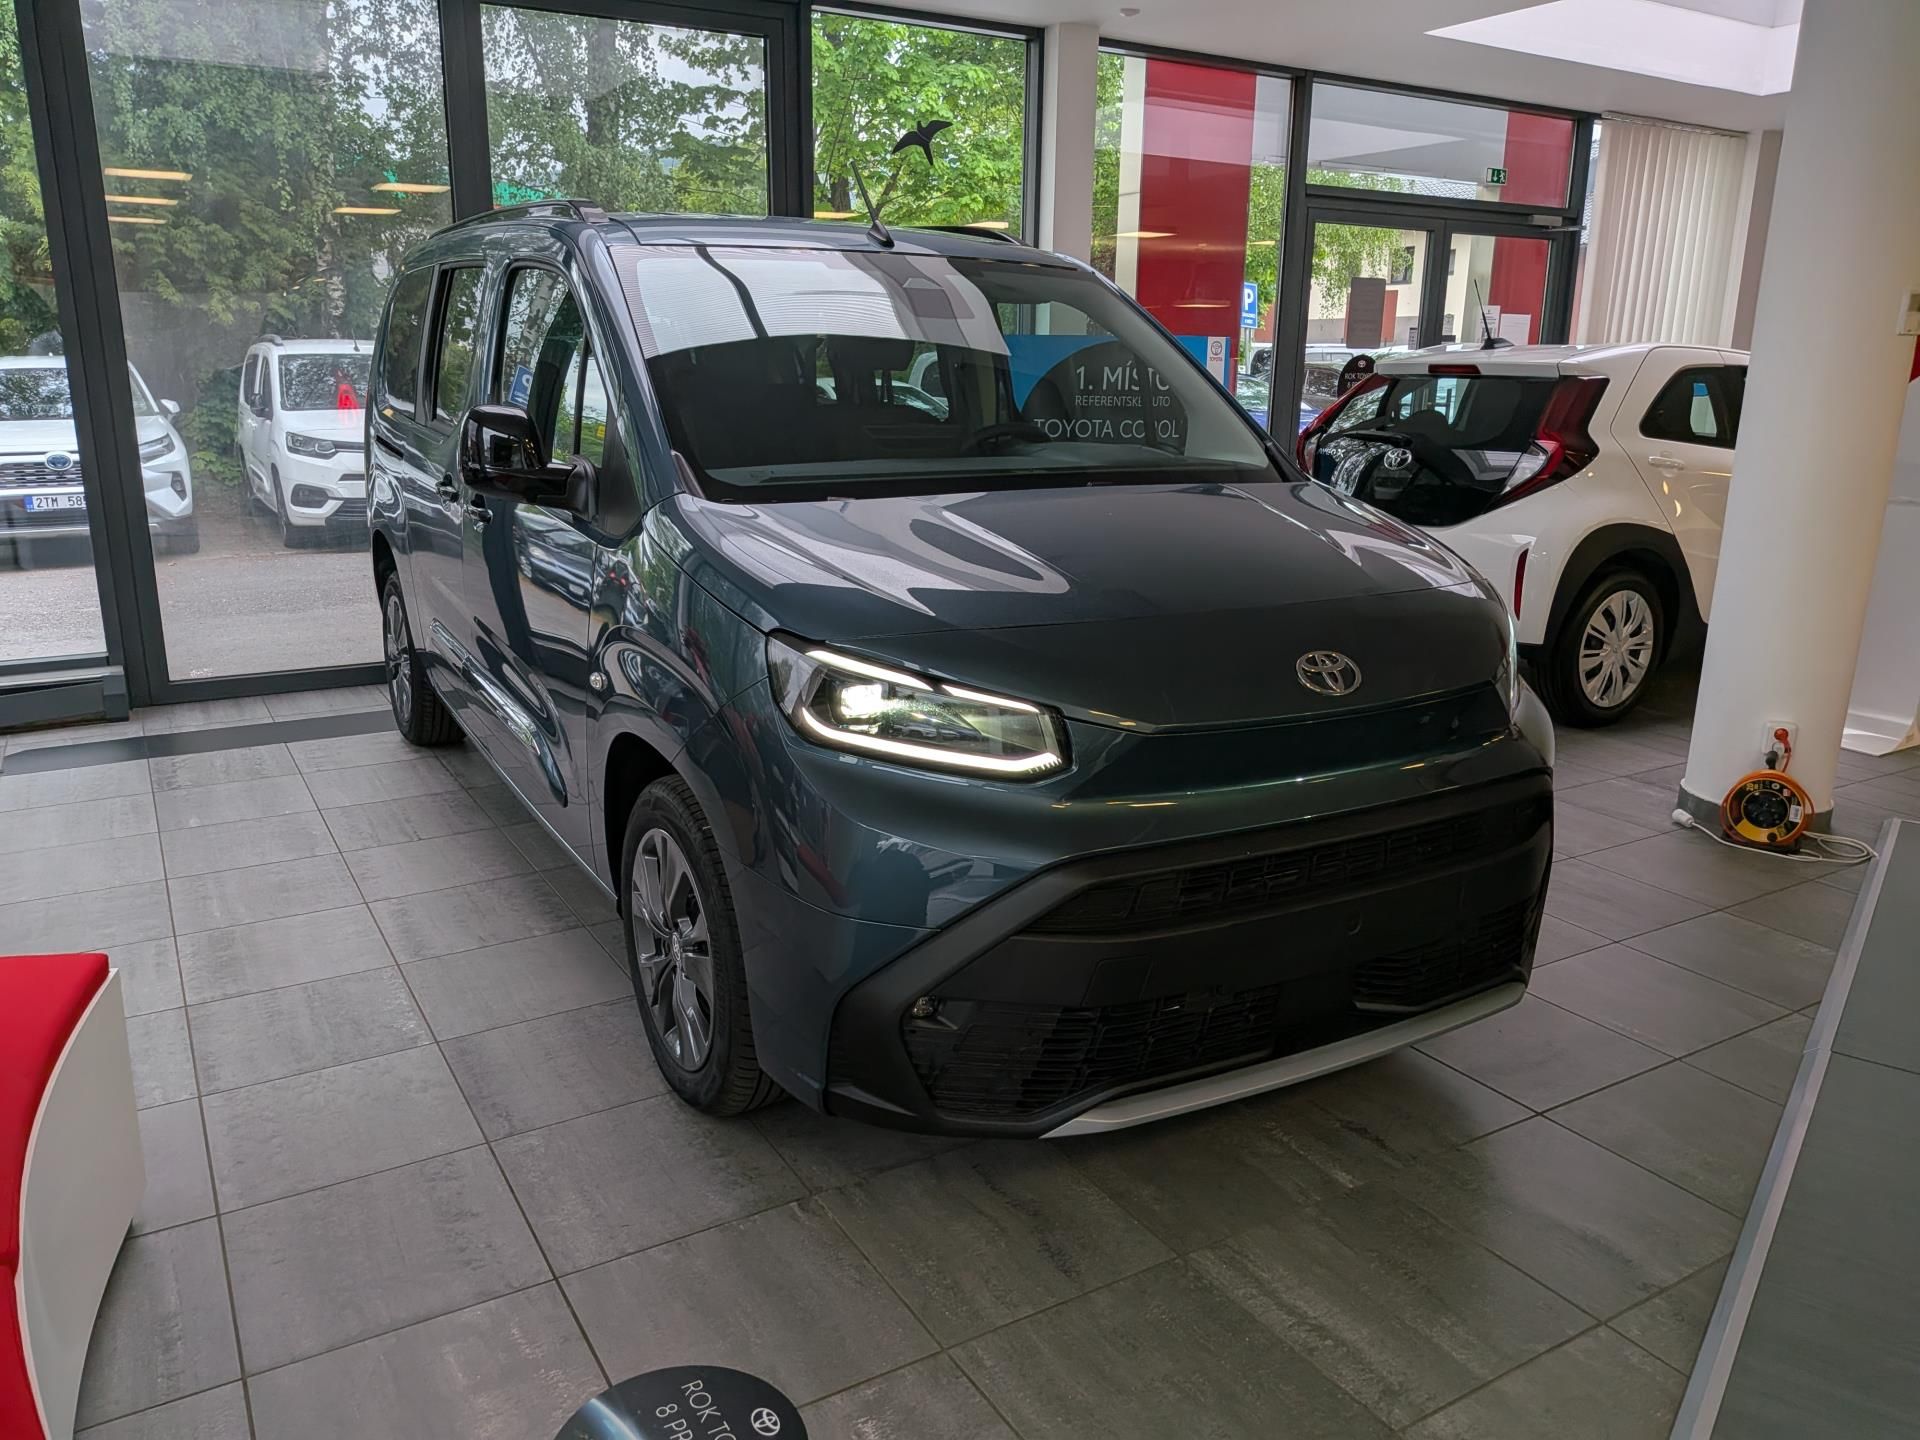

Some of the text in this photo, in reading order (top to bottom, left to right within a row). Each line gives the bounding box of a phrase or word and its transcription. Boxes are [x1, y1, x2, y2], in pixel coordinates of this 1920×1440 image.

[1244, 288, 1254, 311] P
[1076, 366, 1093, 390] 1.
[1152, 395, 1171, 407] UTO
[1033, 419, 1114, 438] TOYOTA
[36, 495, 86, 508] 2TM 58
[655, 1403, 678, 1418] 8
[681, 1380, 721, 1424] ROK
